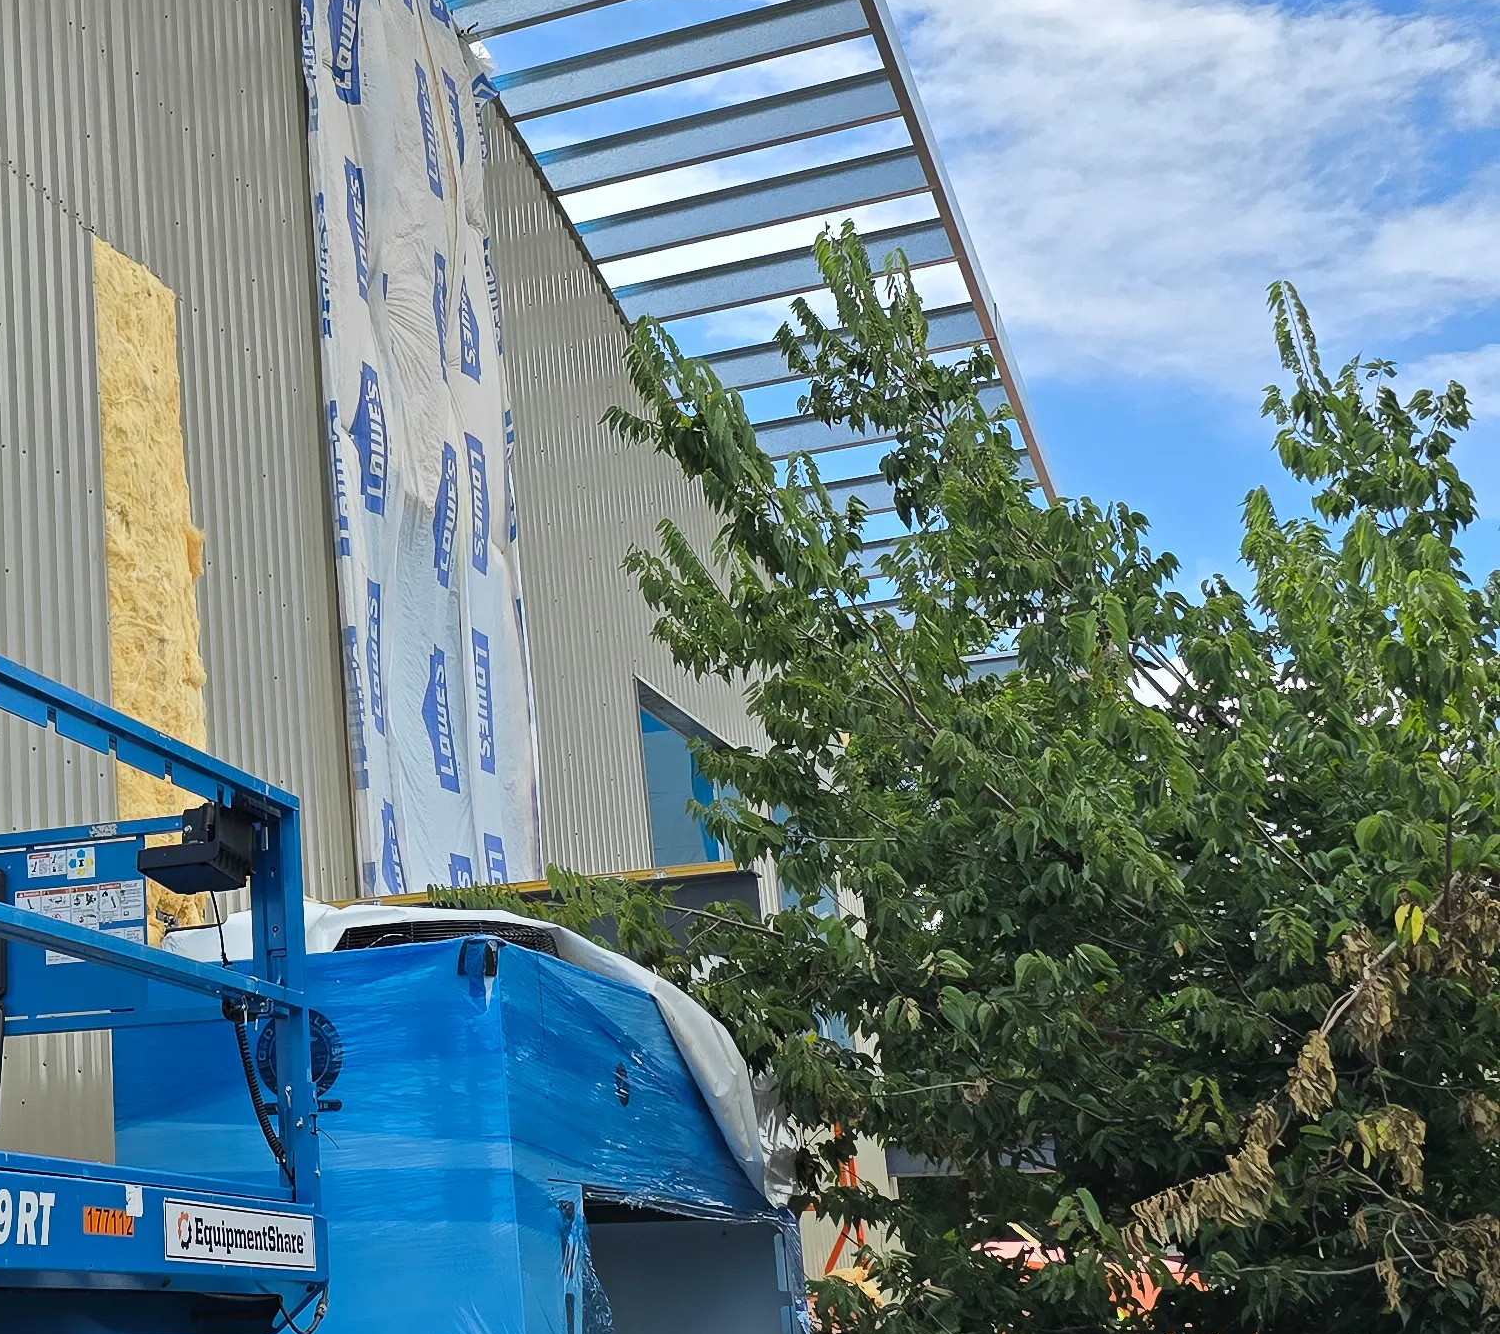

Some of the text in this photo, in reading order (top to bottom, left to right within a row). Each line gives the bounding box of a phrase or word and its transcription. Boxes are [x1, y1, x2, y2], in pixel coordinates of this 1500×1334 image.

[420, 79, 439, 185] LOWE'S
[365, 380, 385, 500] LOWE'S
[439, 459, 457, 573] LOWE'S
[470, 448, 486, 559] LOWE'S
[368, 596, 383, 718] LOWE'S
[475, 645, 492, 759] LOWE'S
[435, 663, 455, 777] LOWE'S
[16, 1190, 56, 1246] RT
[87, 1207, 133, 1236] 177112
[194, 1216, 304, 1254] EquipmentShare
